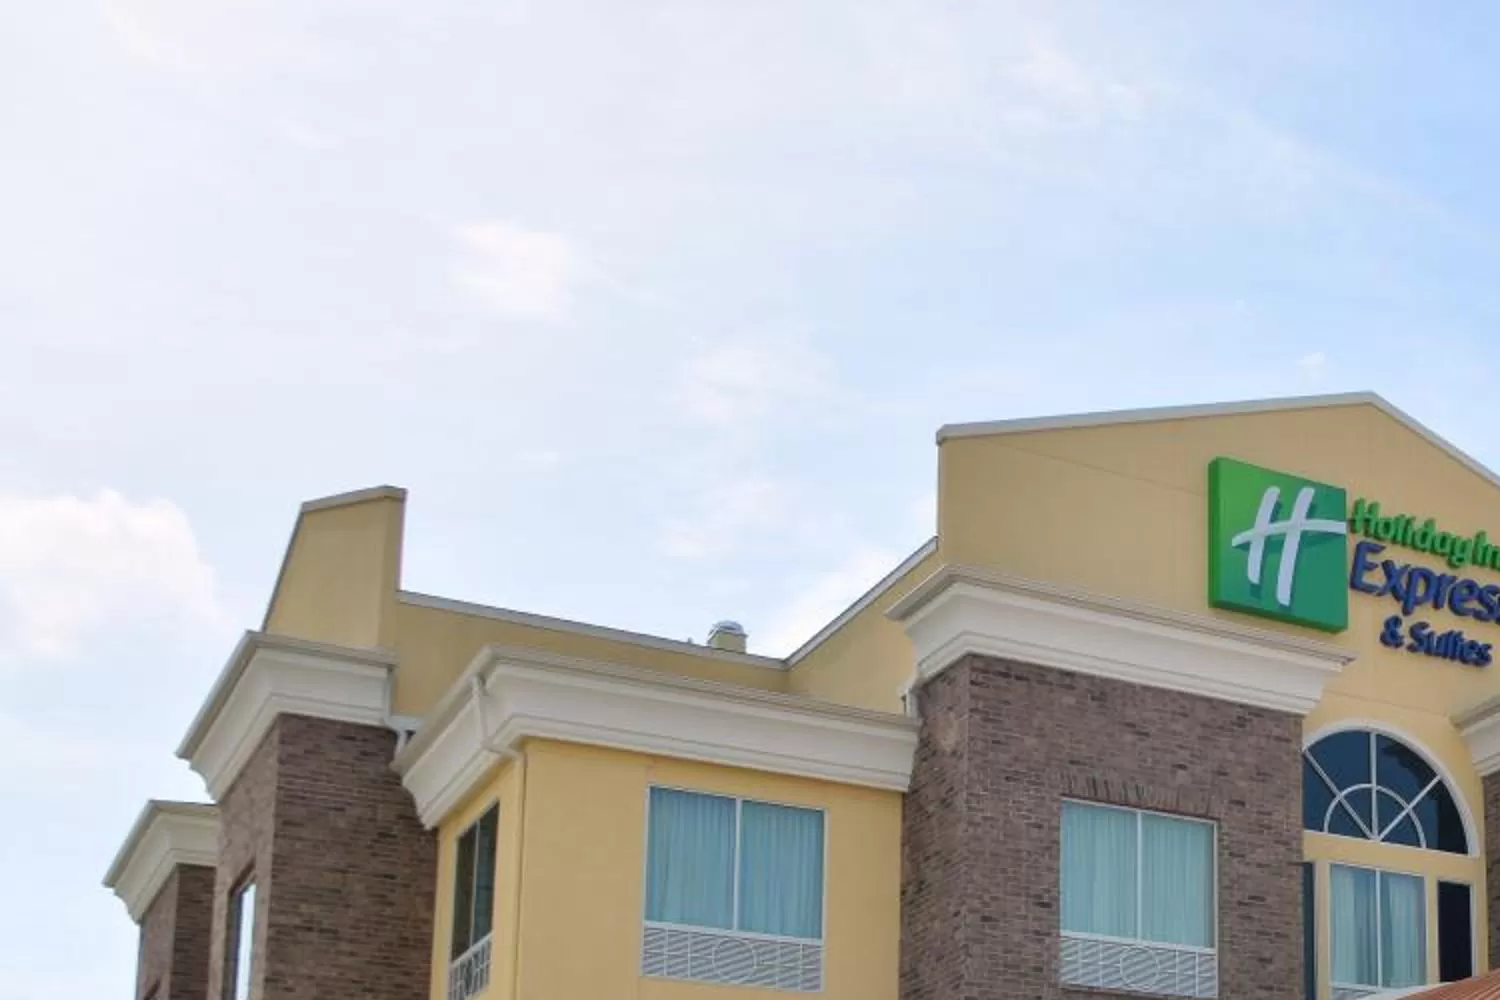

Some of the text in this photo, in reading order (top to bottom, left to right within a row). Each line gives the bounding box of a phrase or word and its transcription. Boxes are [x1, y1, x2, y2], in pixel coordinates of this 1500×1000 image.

[1349, 498, 1473, 568] Holiday
[1379, 615, 1493, 667] & Suites
